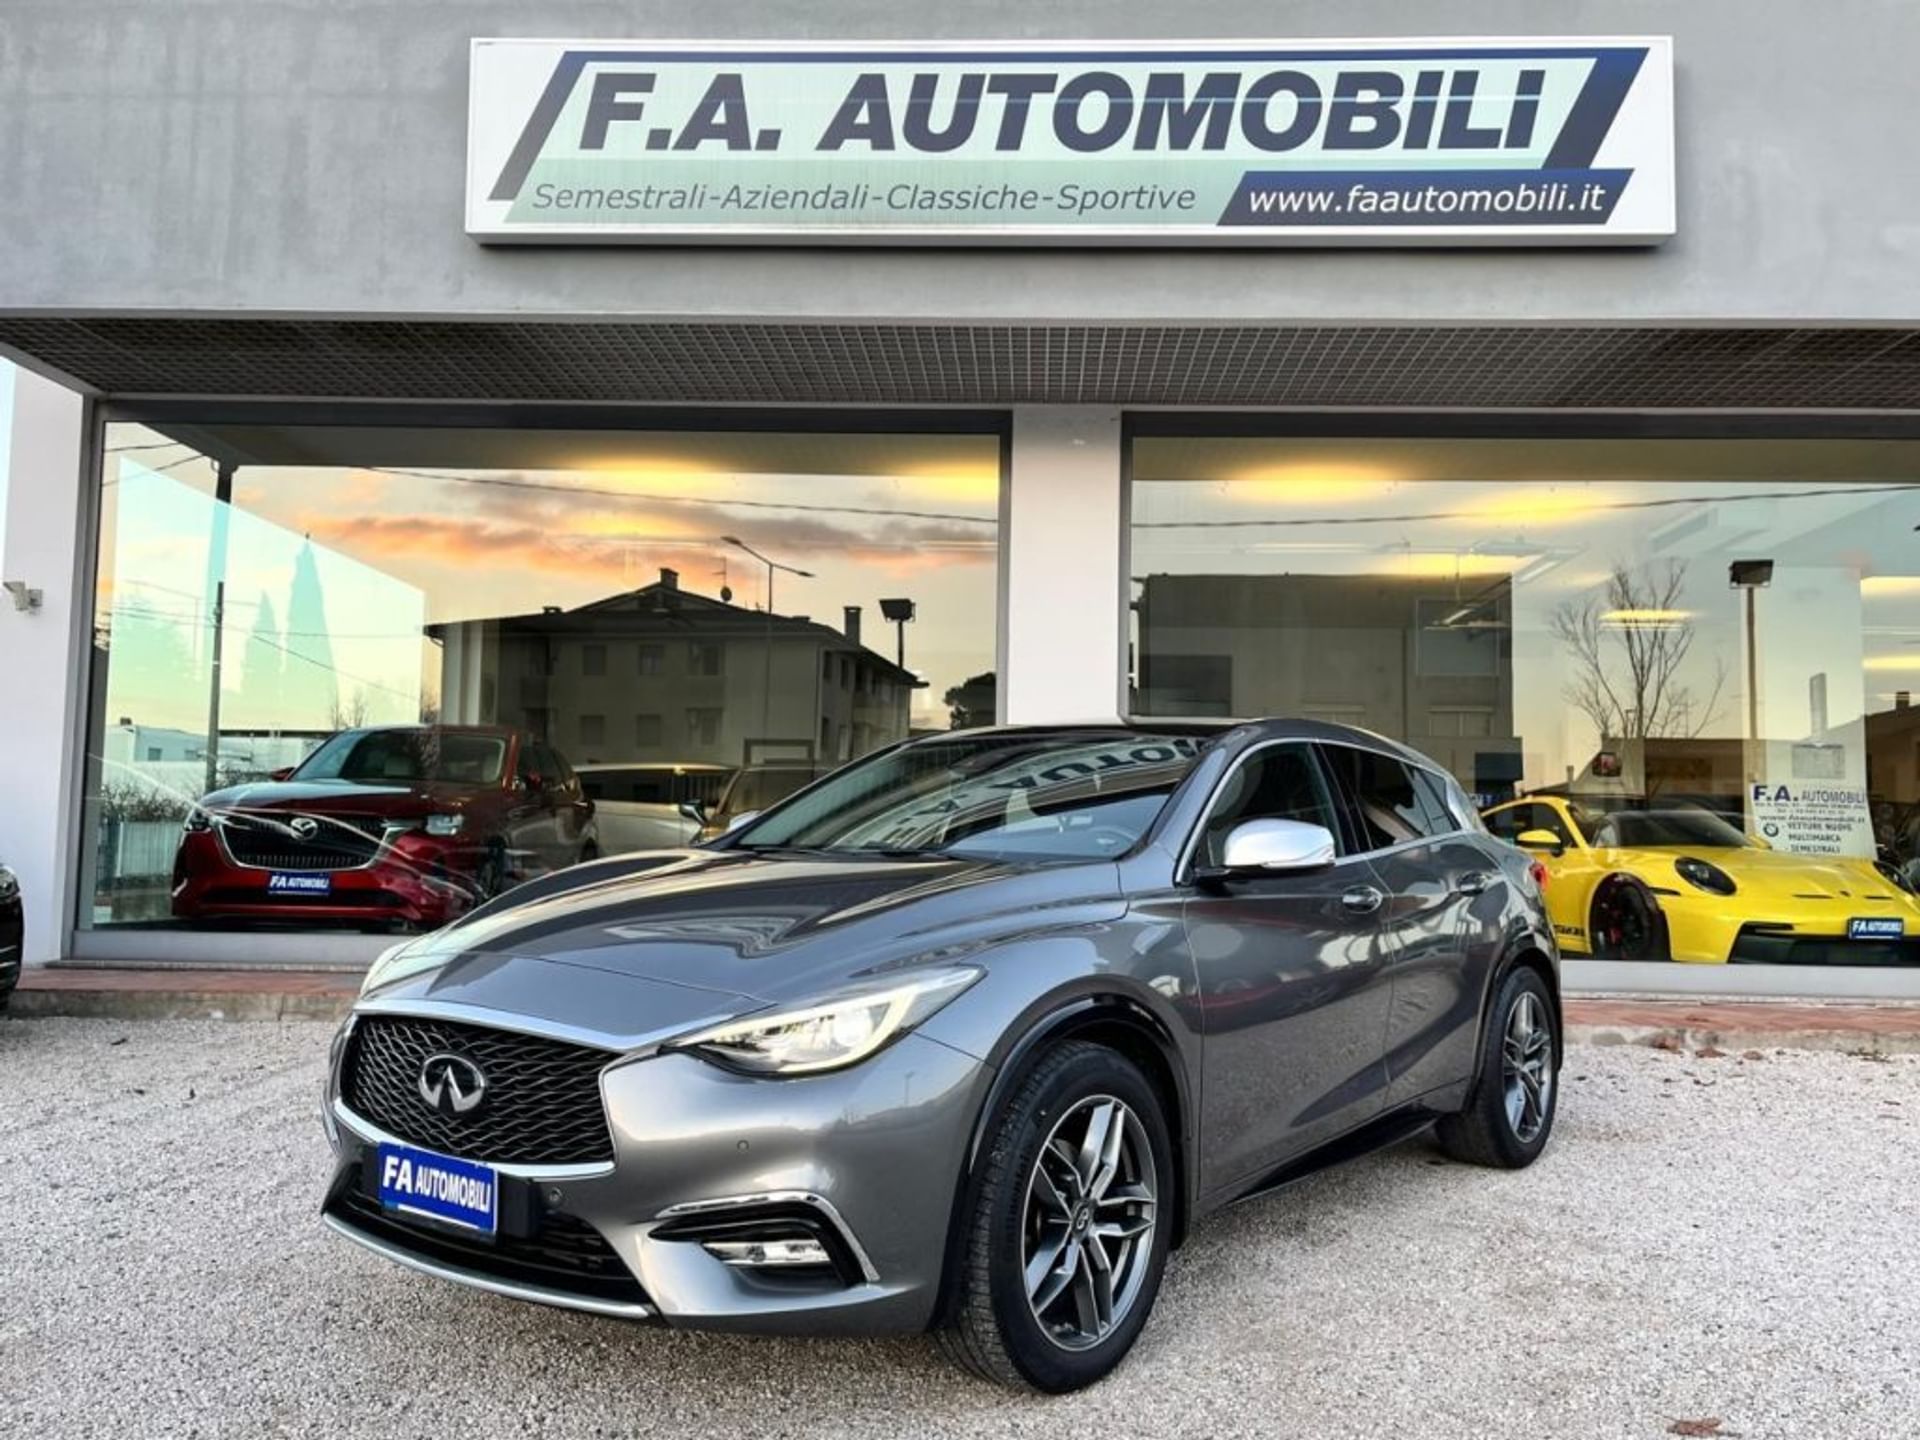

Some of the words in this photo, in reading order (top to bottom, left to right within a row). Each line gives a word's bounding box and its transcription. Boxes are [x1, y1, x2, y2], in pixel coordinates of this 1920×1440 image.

[578, 72, 781, 151] F.A.
[815, 69, 1546, 153] AUTOMOBILI
[532, 183, 1196, 215] Semestrali-Aziendali-Classiche-Sportive
[1248, 183, 1606, 212] www.faautomobili.it
[1753, 785, 1799, 801] F.A.
[1802, 790, 1865, 803] AUTOMOBILI
[270, 875, 286, 888] FA
[382, 1155, 412, 1194] FA
[415, 1165, 491, 1213] AUTOMOBILI
